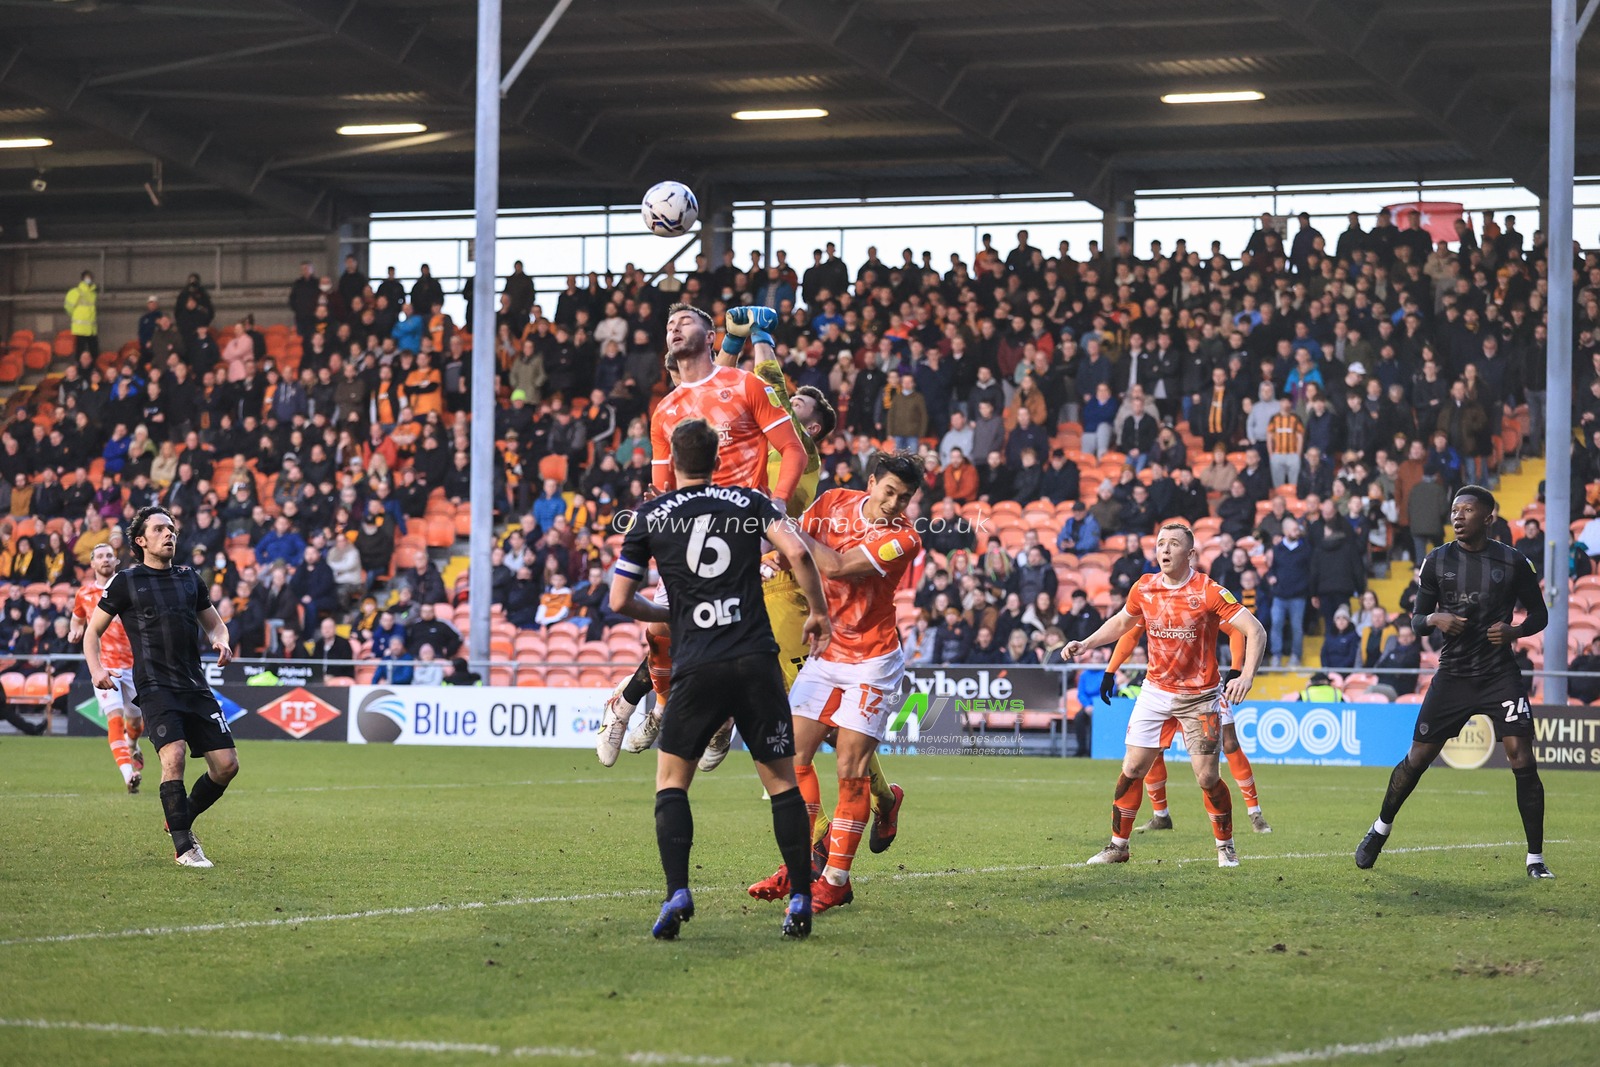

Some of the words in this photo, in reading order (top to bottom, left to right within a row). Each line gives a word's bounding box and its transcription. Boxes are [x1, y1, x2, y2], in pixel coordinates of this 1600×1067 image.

[686, 513, 731, 578] 6
[281, 701, 317, 721] FTS
[859, 683, 884, 715] 12
[1502, 697, 1531, 723] 24
[414, 702, 477, 737] Blue
[489, 703, 556, 737] CDM
[1533, 717, 1600, 743] WHIT
